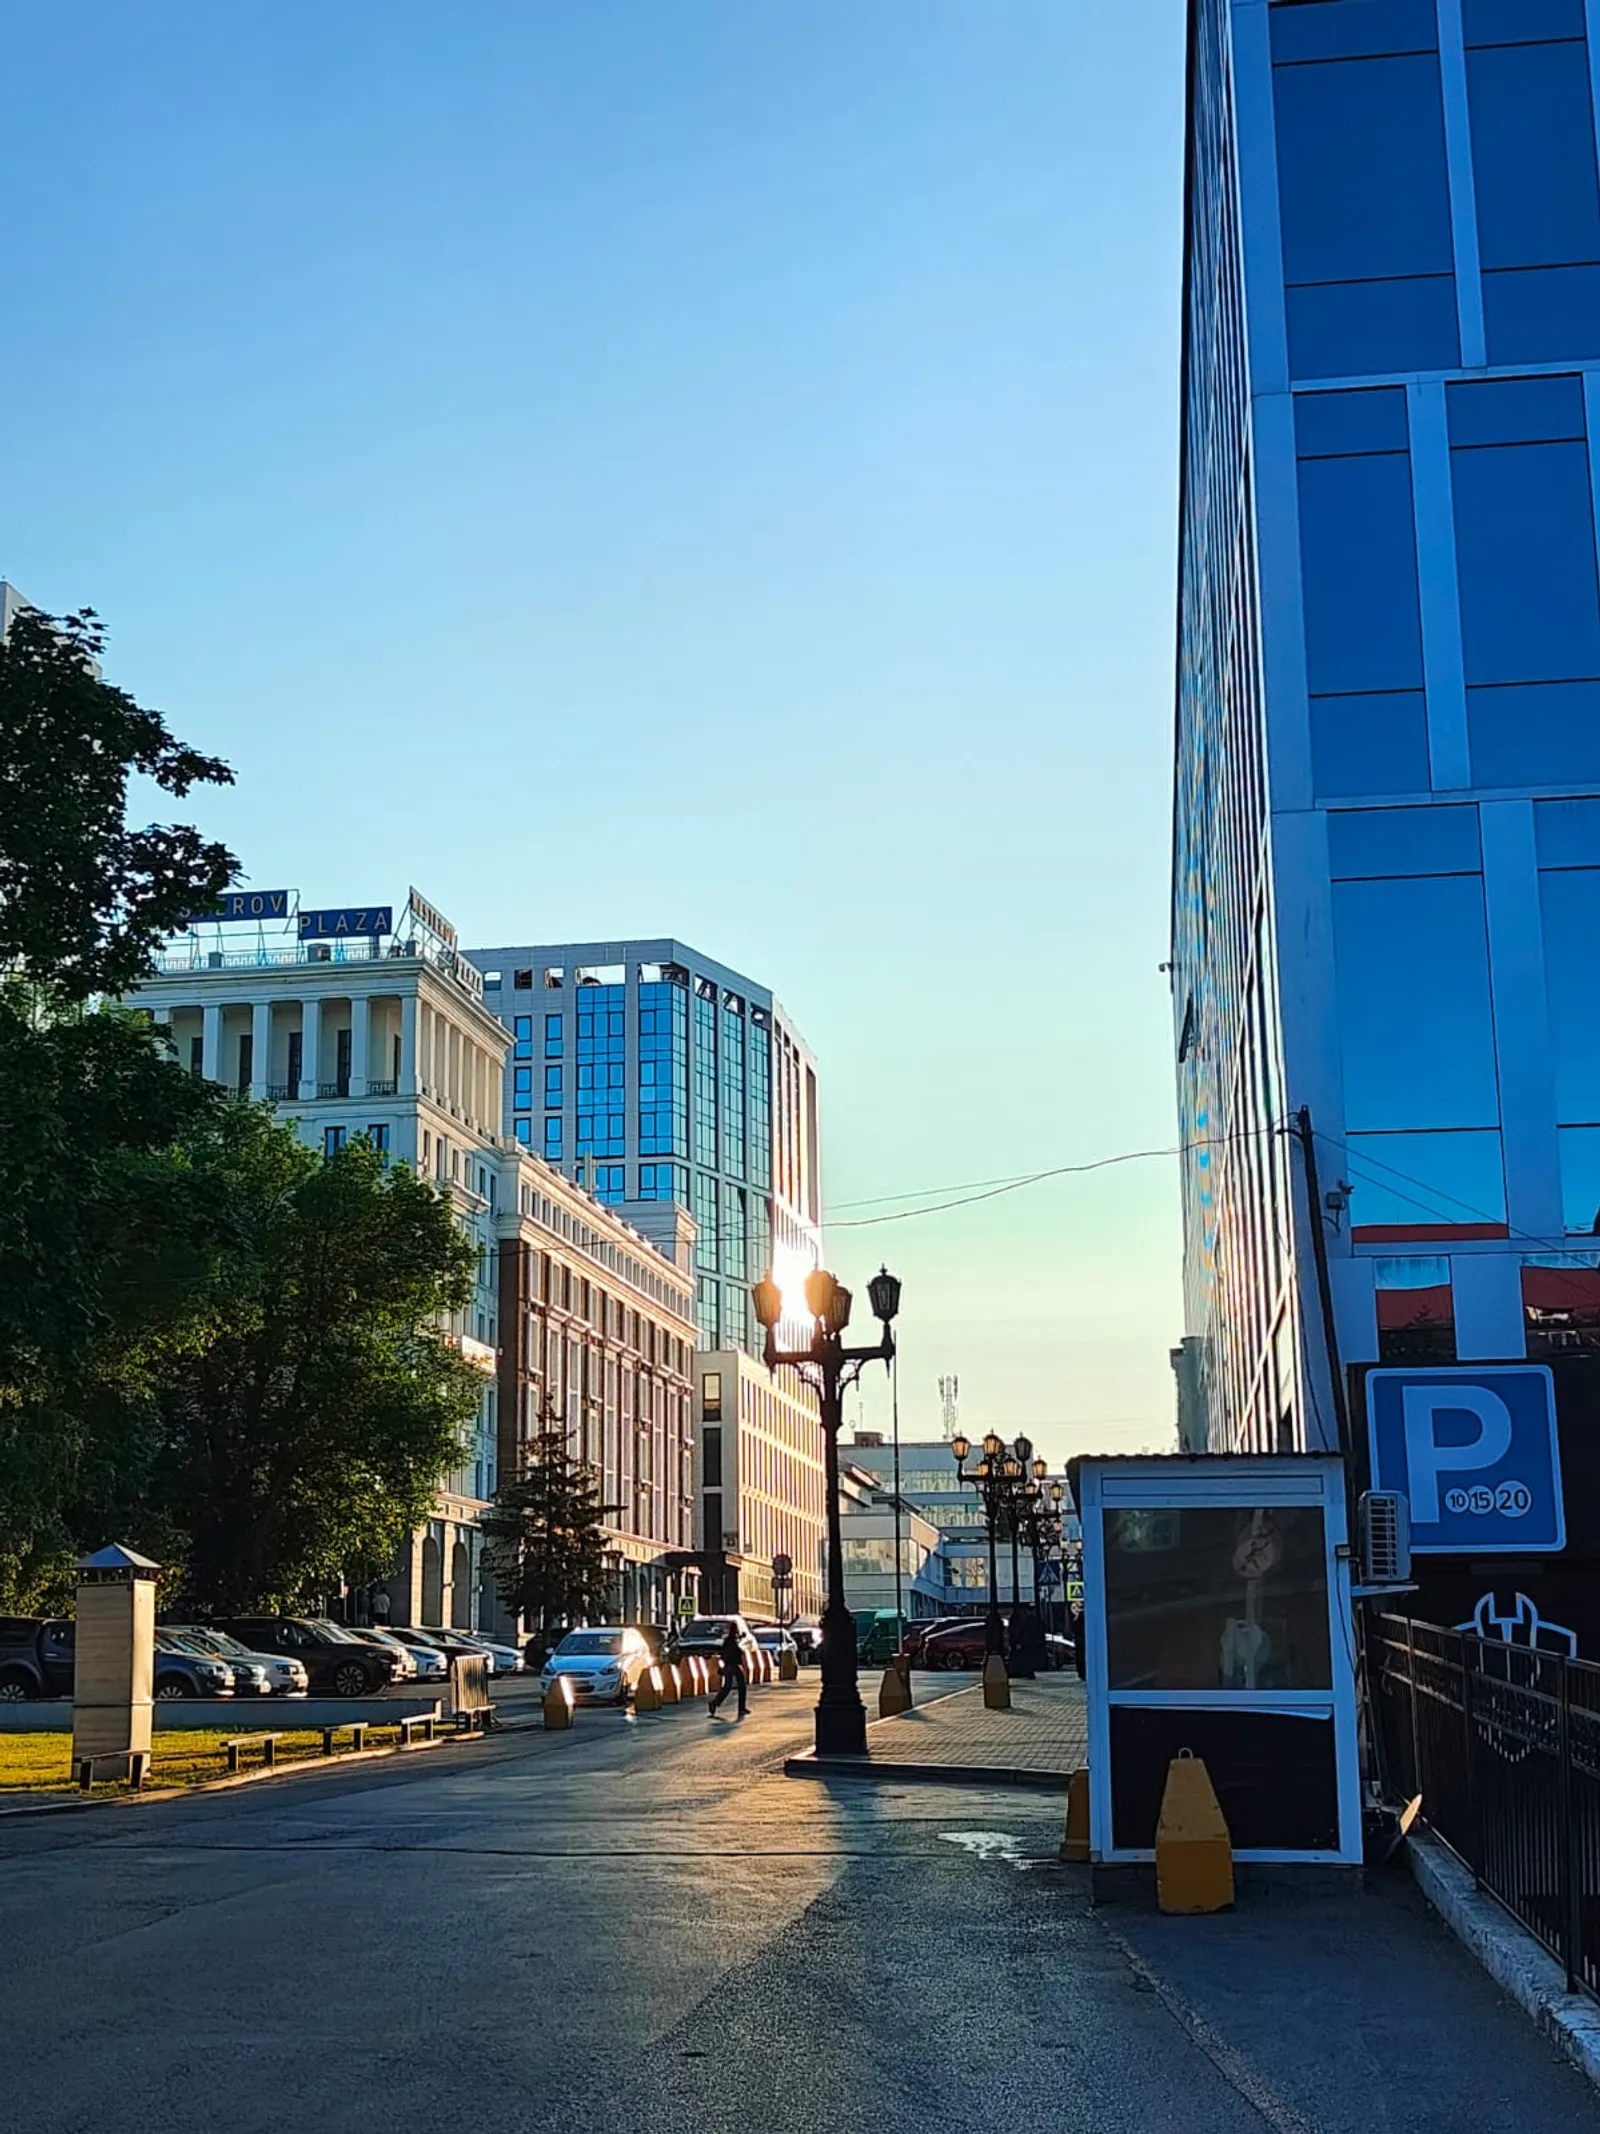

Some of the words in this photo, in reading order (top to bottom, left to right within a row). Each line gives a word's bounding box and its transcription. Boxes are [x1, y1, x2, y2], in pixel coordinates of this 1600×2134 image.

[299, 911, 388, 934] PLAZA
[1402, 1385, 1512, 1523] P
[1450, 1493, 1466, 1508] 10
[1471, 1490, 1491, 1510] 15
[1498, 1488, 1529, 1511] 20
